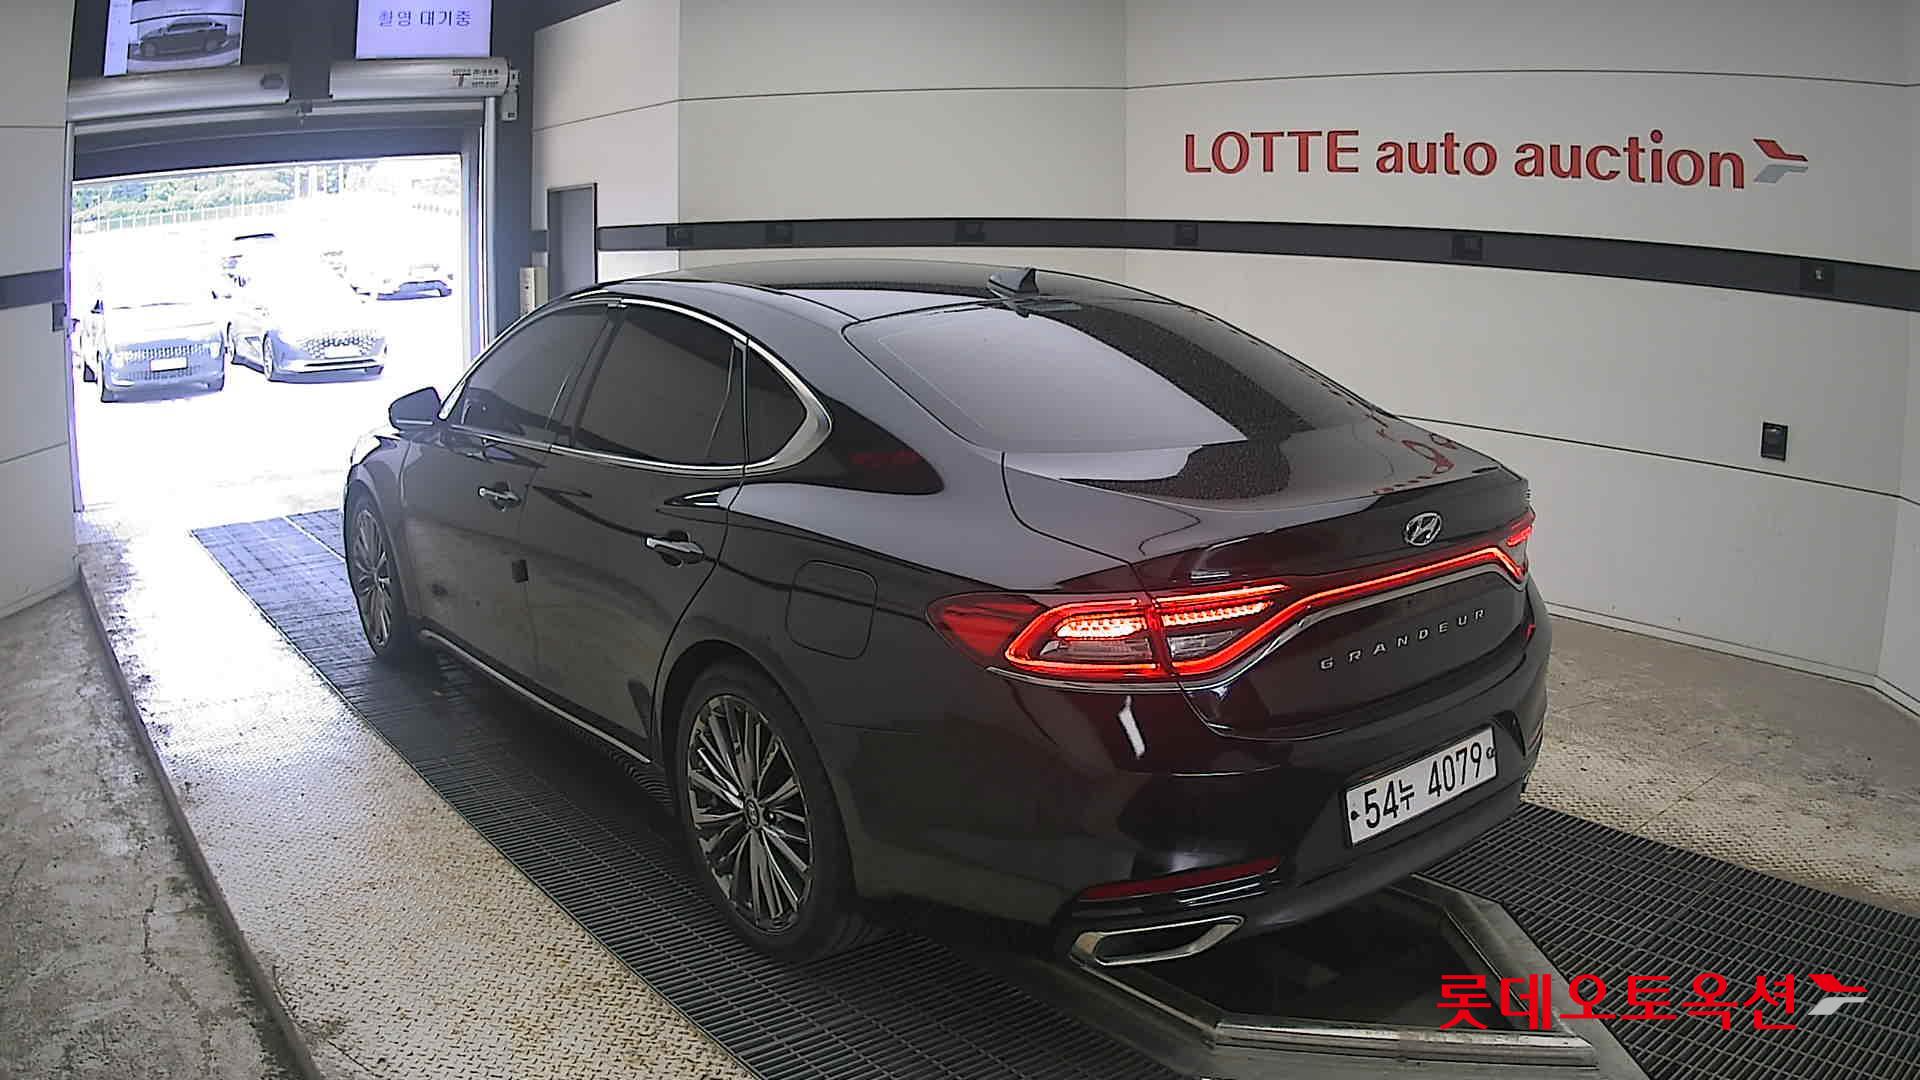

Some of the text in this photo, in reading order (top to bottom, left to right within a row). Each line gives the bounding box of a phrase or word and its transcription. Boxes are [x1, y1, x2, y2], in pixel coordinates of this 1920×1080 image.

[378, 9, 472, 27] 촬영 대기중
[1184, 129, 1745, 189] LOTTE auto auction
[1319, 608, 1486, 671] GRANDEUR
[1363, 742, 1483, 829] 54누 4079
